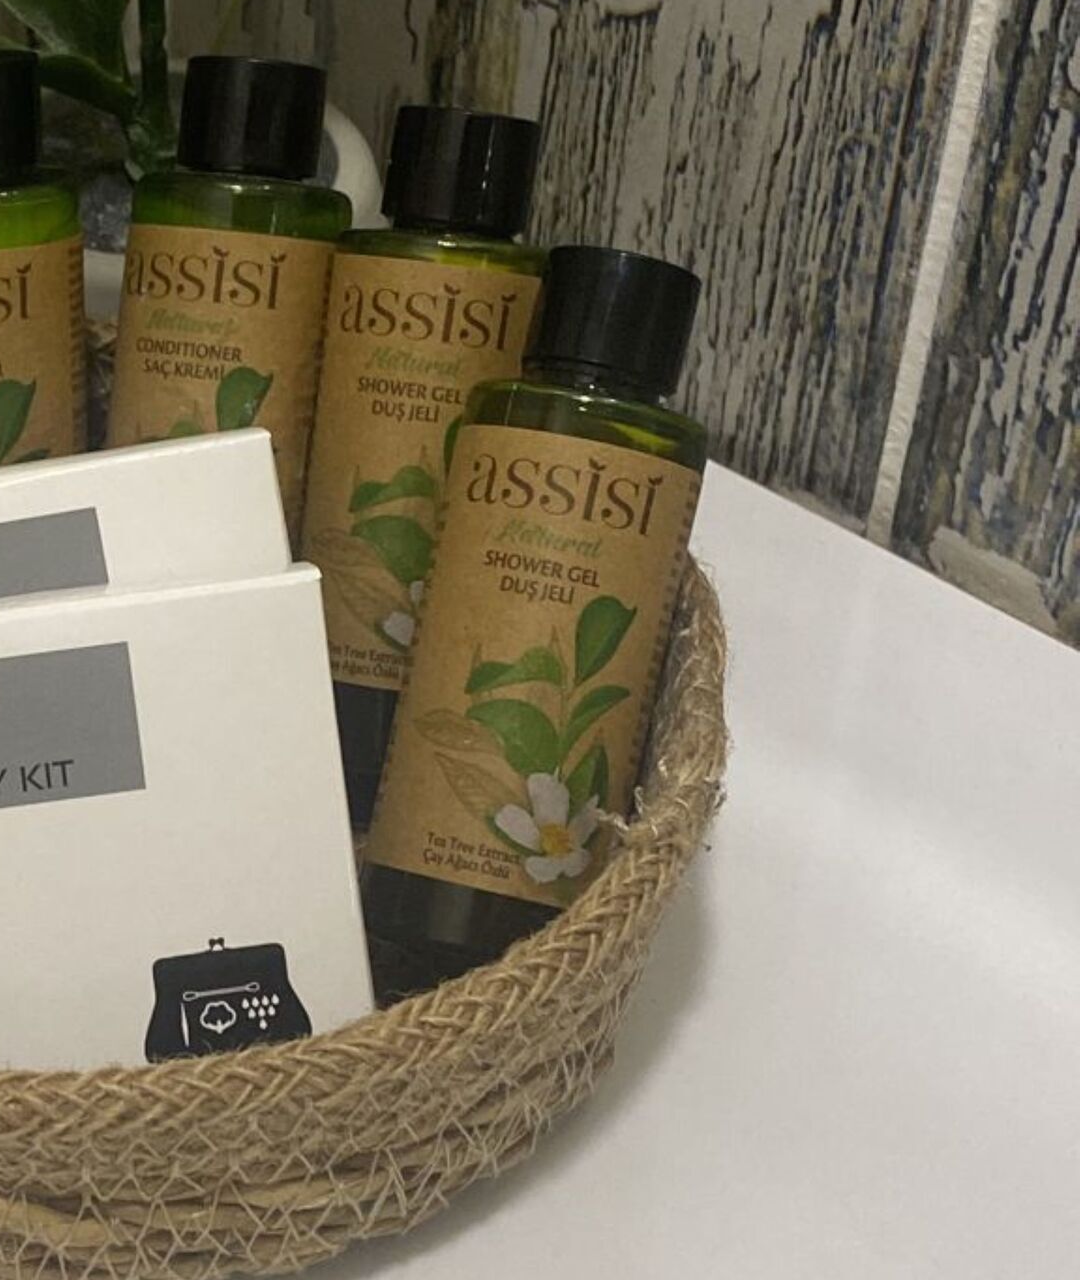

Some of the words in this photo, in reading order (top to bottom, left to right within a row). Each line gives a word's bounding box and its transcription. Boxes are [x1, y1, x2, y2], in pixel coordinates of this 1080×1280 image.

[127, 246, 287, 310] assisi
[340, 283, 516, 350] assisi
[136, 337, 242, 362] CONDITIONER
[144, 359, 170, 380] SAÇ
[357, 376, 427, 400] SHOWER
[431, 386, 462, 405] GEL
[371, 400, 405, 423] DUŞ
[467, 453, 663, 536] assisi
[482, 549, 564, 579] SHOWER
[567, 566, 601, 588] GEL
[500, 575, 538, 602] DUŞ
[20, 760, 74, 792] KIT
